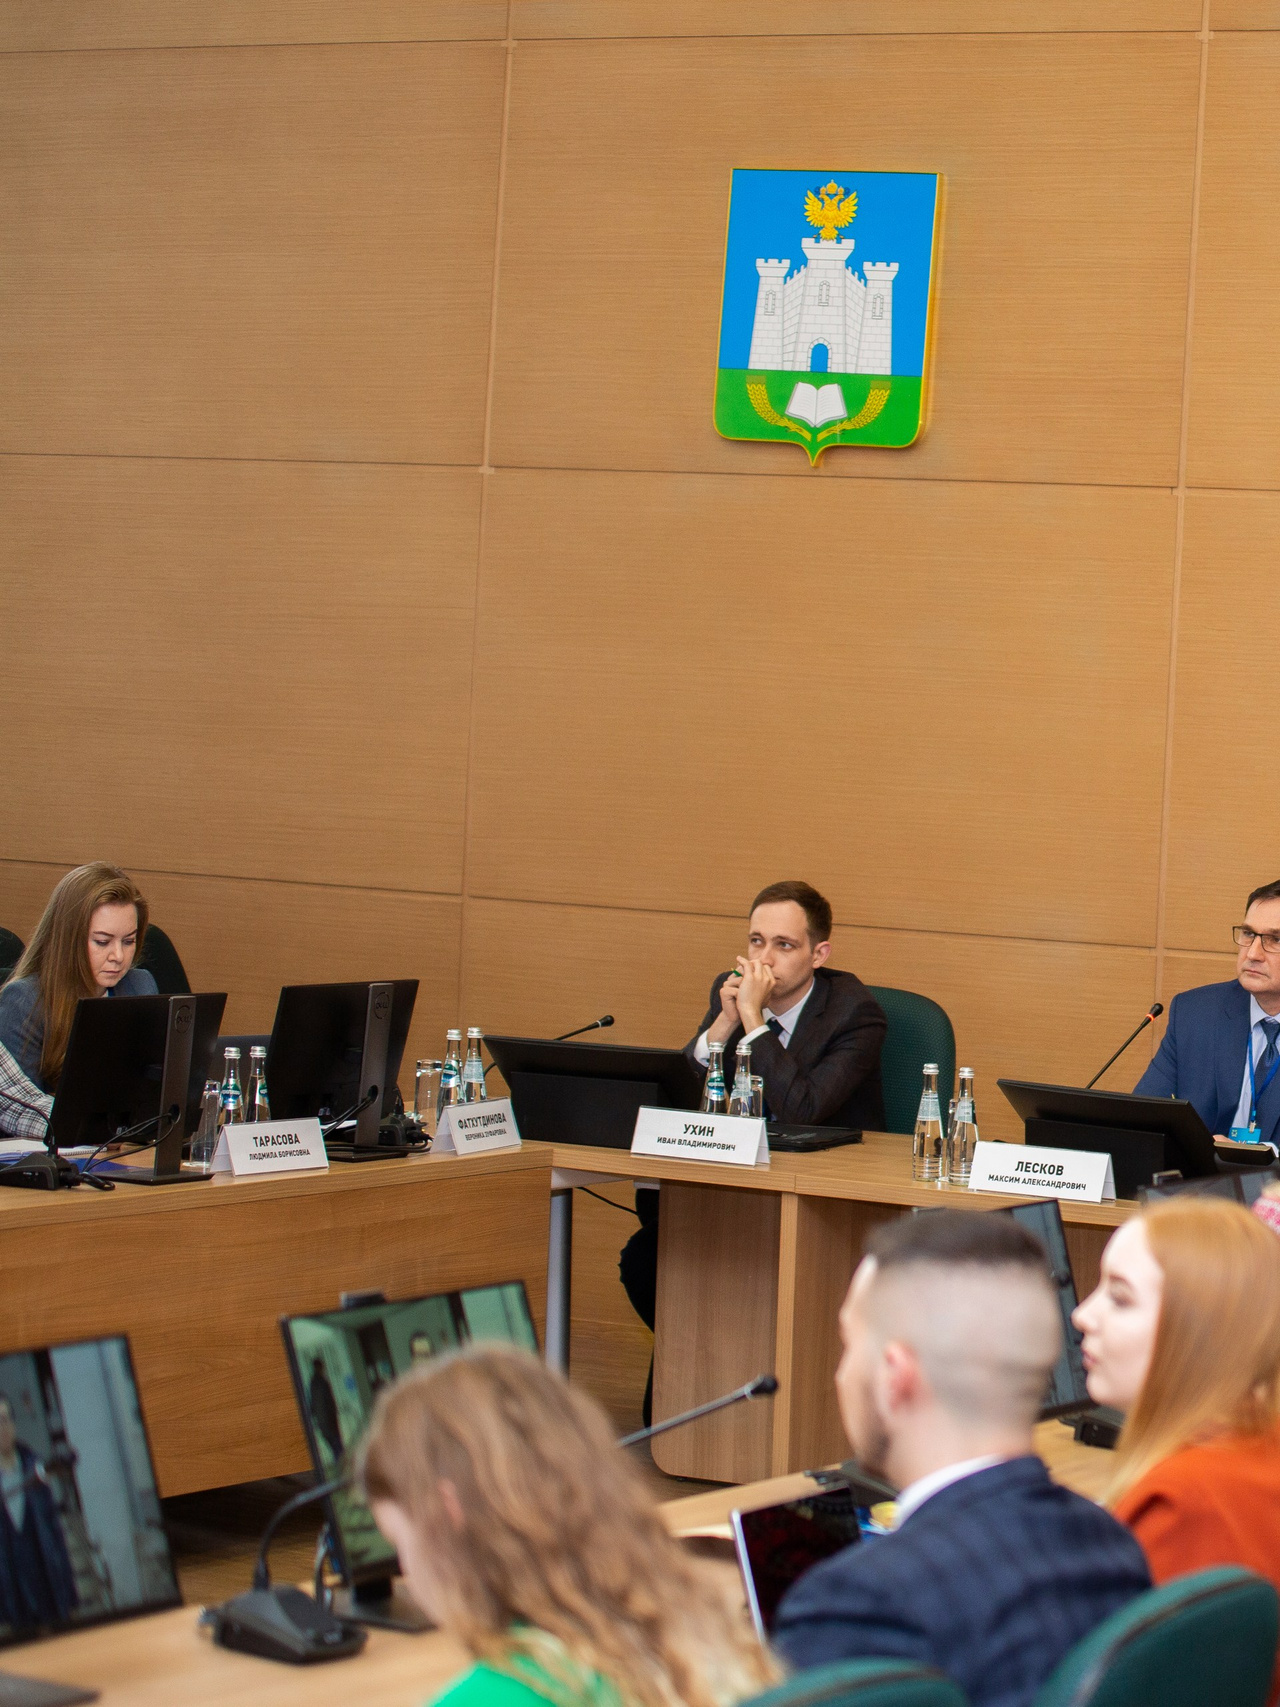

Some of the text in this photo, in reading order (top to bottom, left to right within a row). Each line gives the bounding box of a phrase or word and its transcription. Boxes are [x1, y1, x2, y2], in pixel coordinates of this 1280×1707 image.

[458, 1112, 507, 1129] ФАТХУТДИНОВА
[465, 1131, 485, 1141] ВЕРОНИКА
[683, 1123, 715, 1137] УХИН
[252, 1133, 301, 1147] ТАРАСОВА
[657, 1136, 736, 1152] ИВАН ВЛАДИМИРОВИЧ
[249, 1148, 311, 1161] ЛЮДМИЛА БОРИСОВНА
[1015, 1160, 1064, 1176] ЛЕСКОВ
[988, 1173, 1087, 1191] МАКСИМ АЛЕКСАНДРОВИЧ
